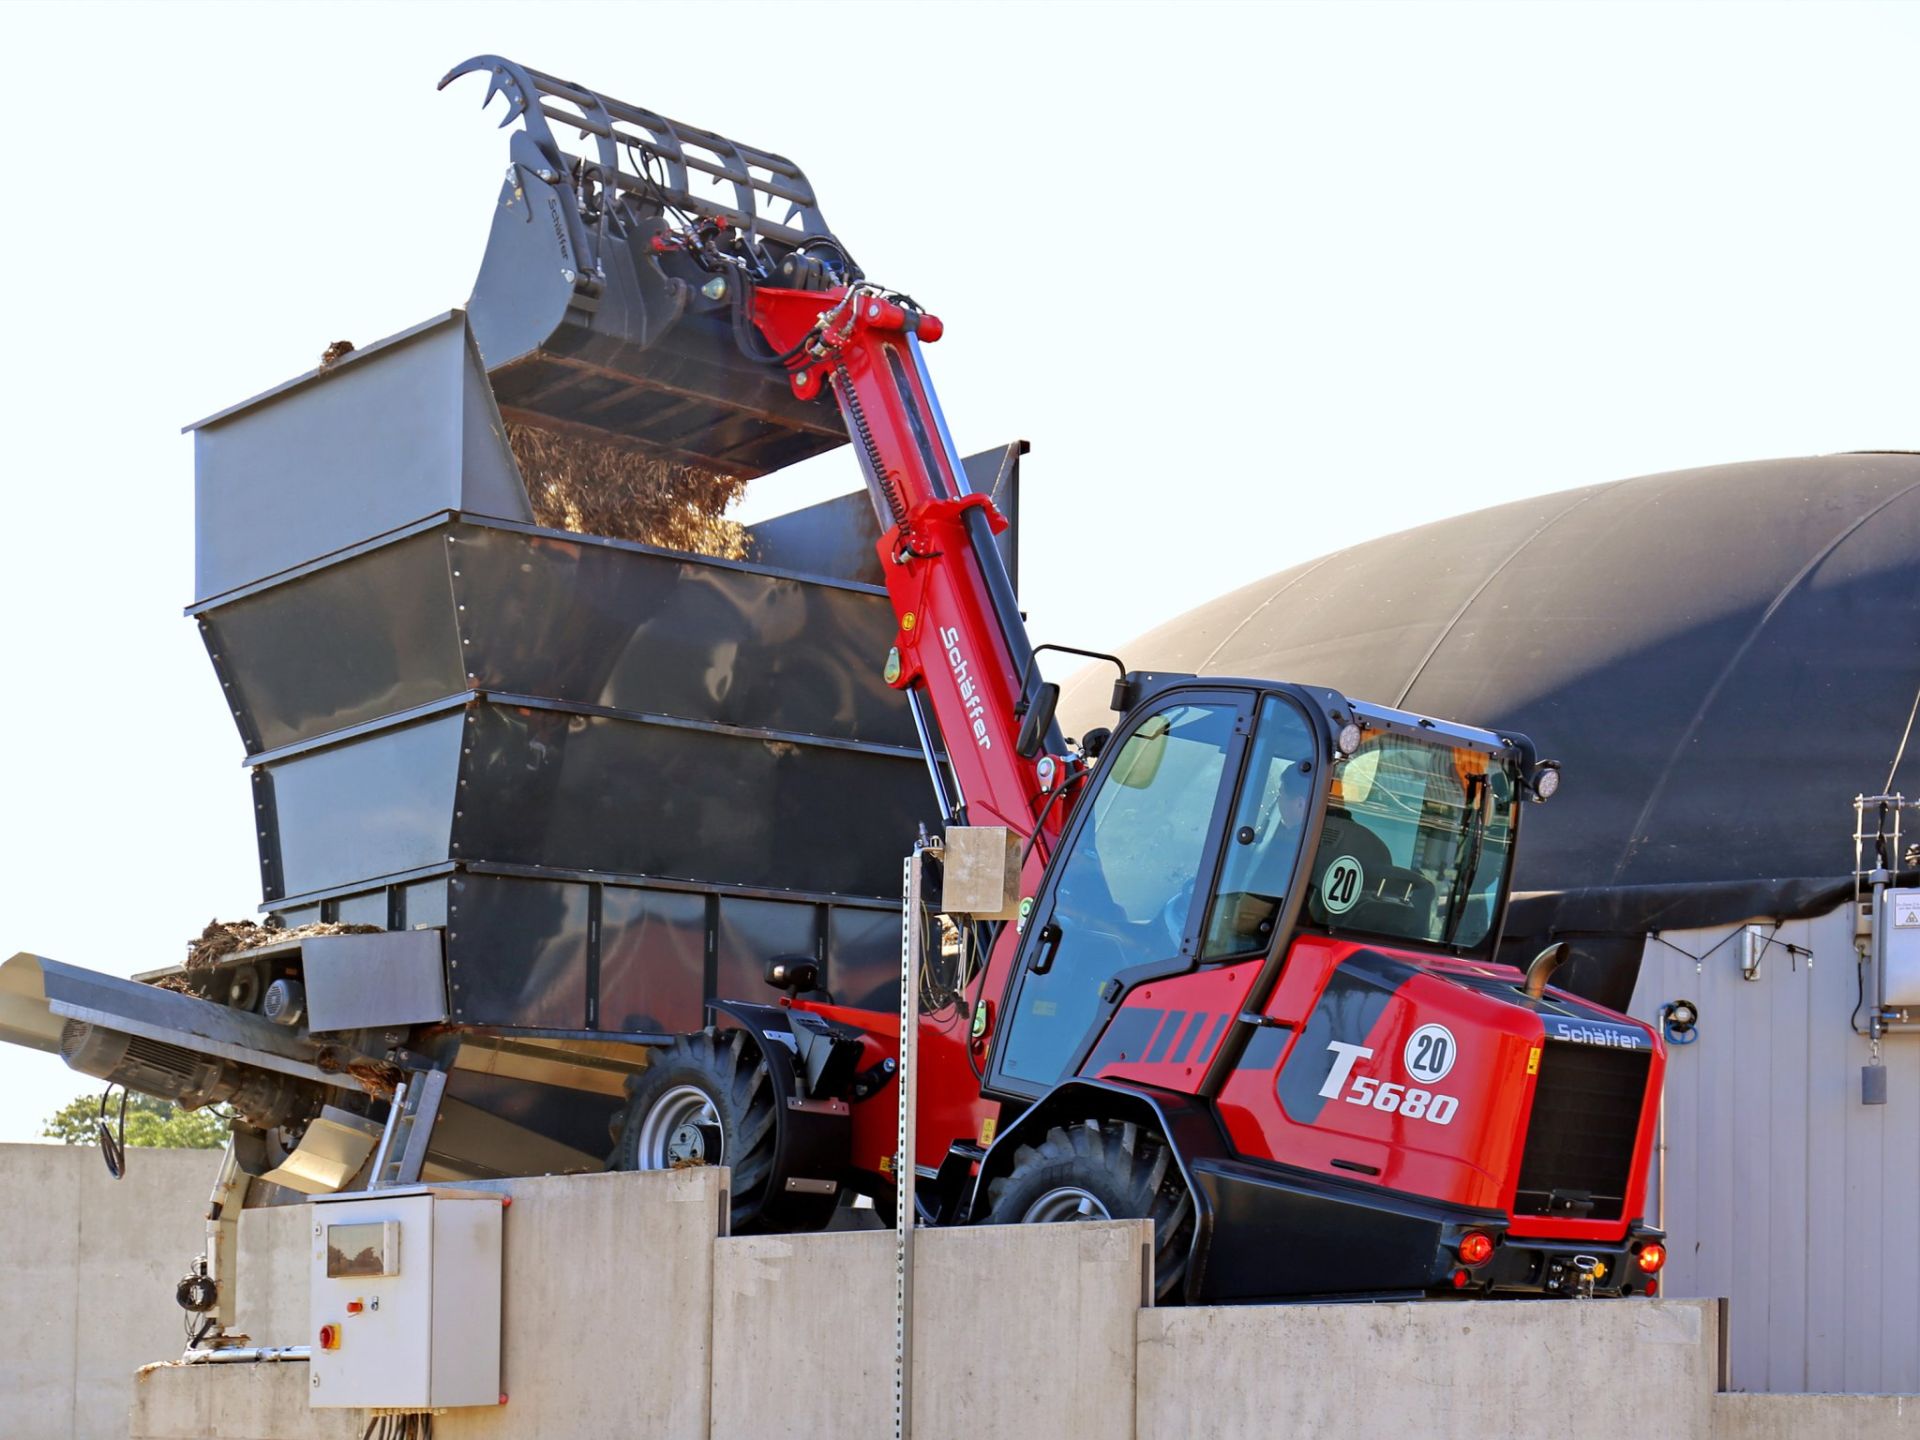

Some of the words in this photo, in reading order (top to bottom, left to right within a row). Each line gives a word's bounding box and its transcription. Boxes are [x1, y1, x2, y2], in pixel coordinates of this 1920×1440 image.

[940, 626, 991, 750] Schäffer
[1328, 866, 1357, 904] 20
[1413, 1034, 1447, 1074] 20
[1553, 1023, 1641, 1049] Schäffer
